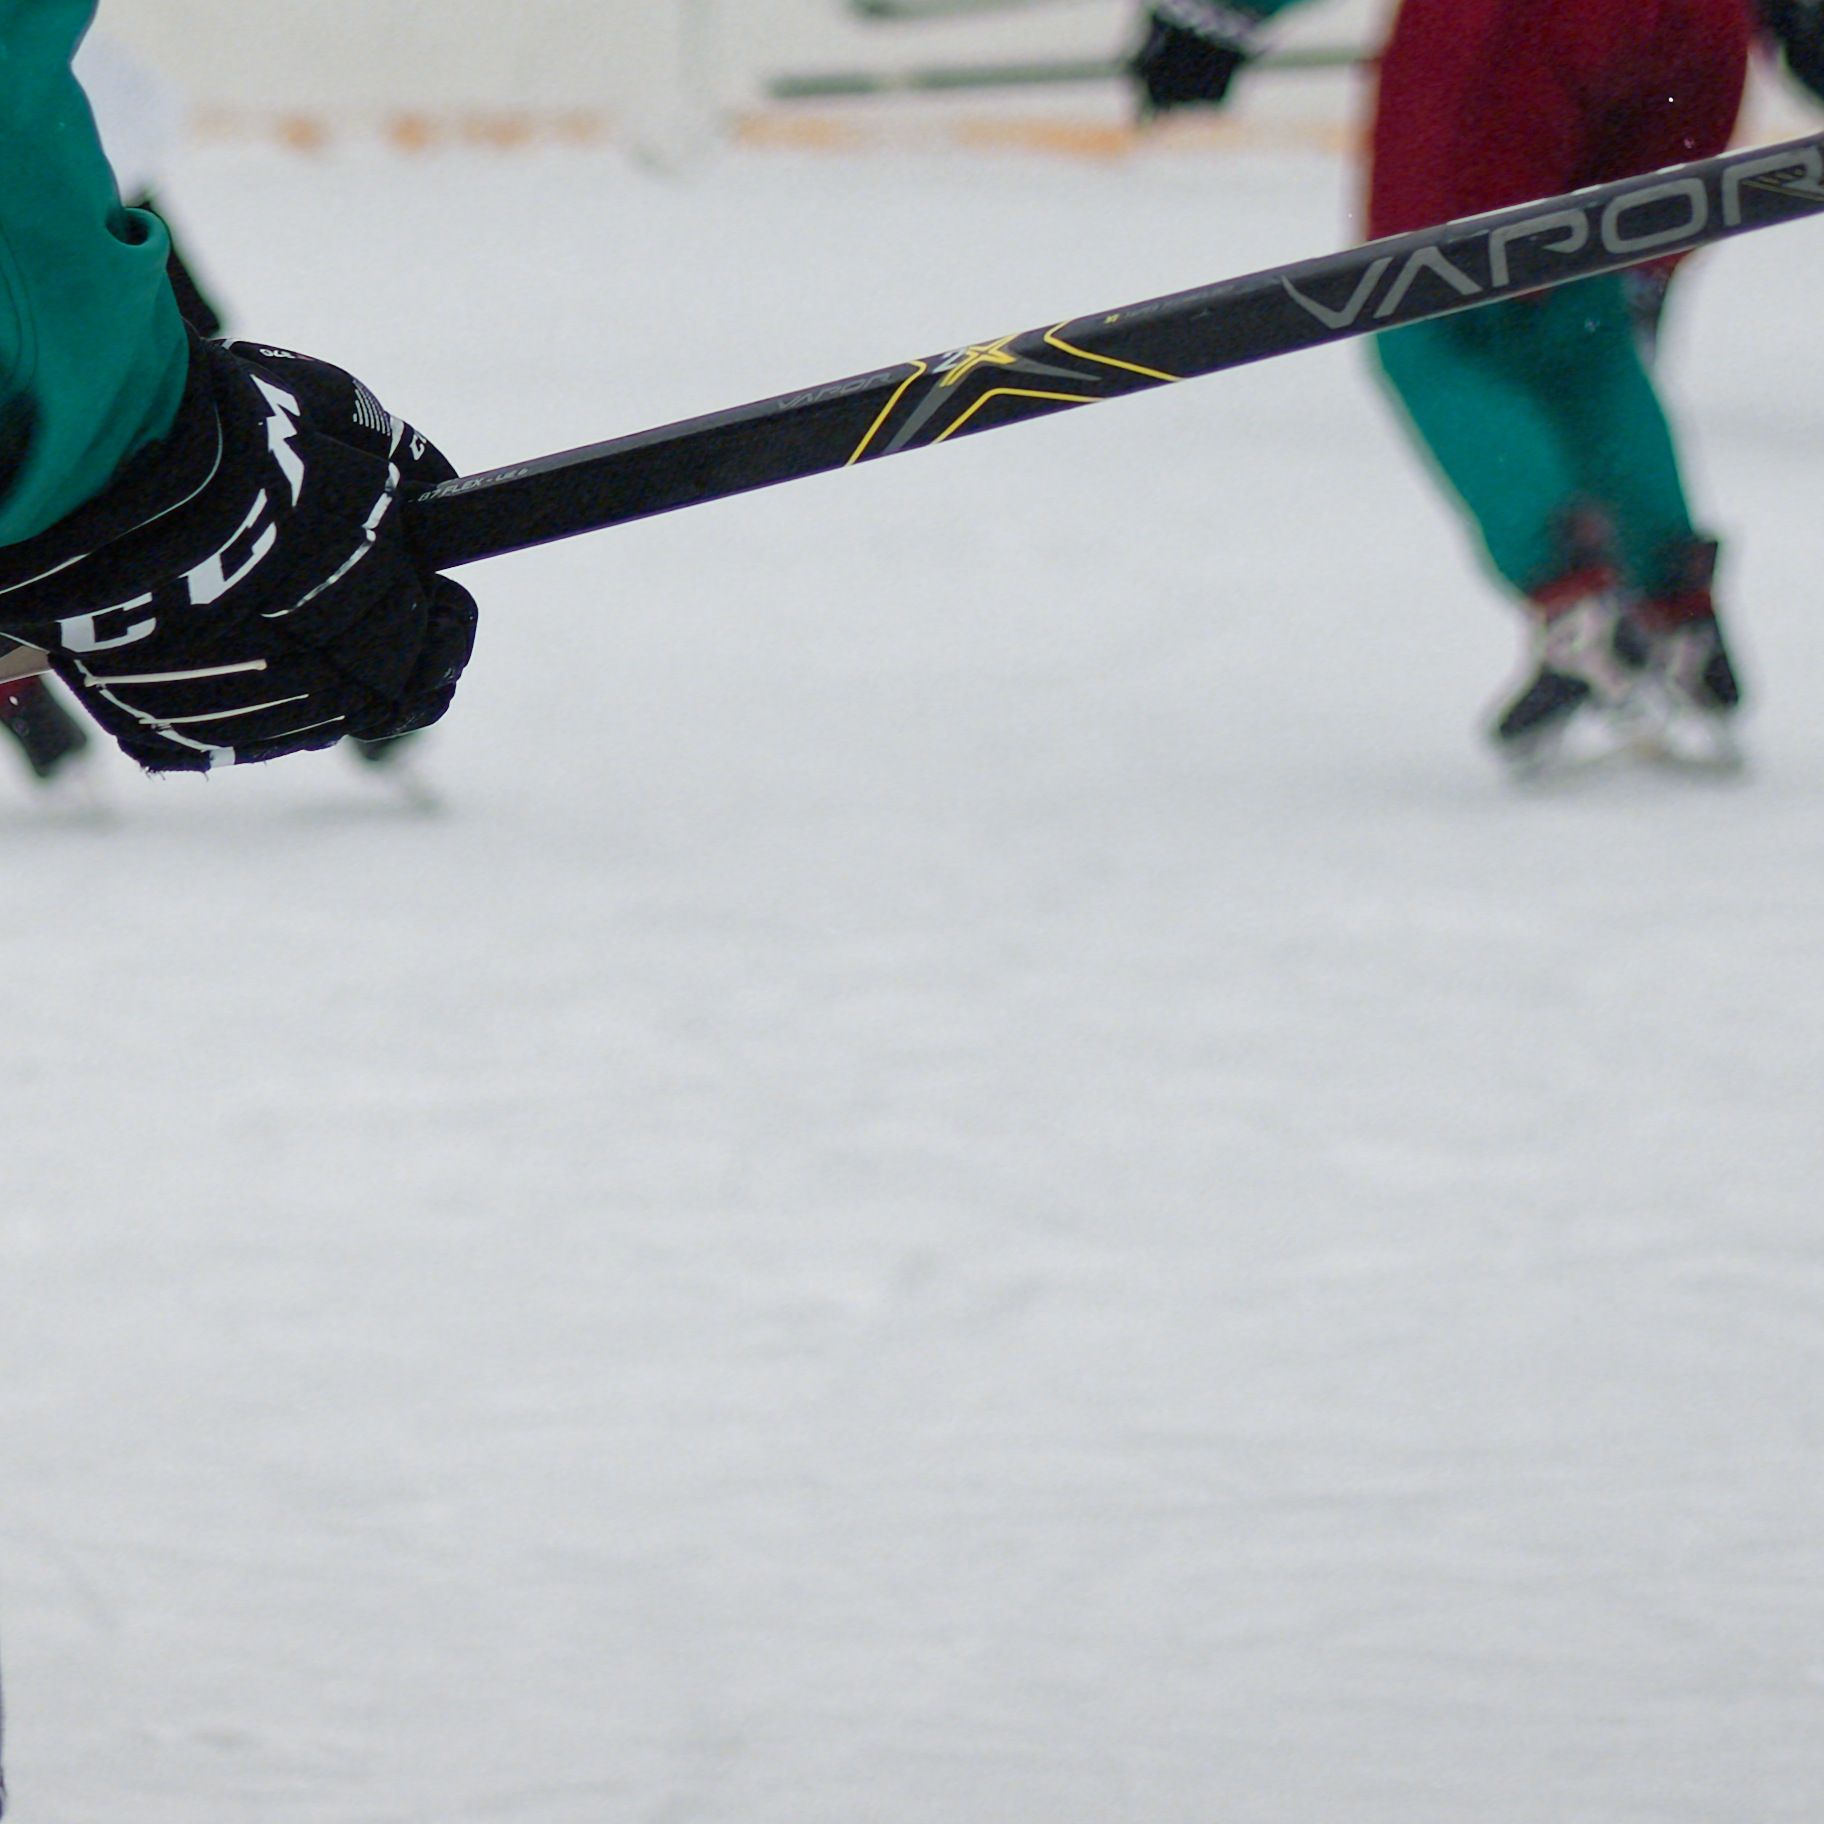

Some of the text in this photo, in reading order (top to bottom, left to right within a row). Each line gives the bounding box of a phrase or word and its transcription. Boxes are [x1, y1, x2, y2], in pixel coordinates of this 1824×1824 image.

[933, 332, 1022, 388] 2X
[778, 372, 891, 409] VAPOR
[55, 374, 305, 653] CCM
